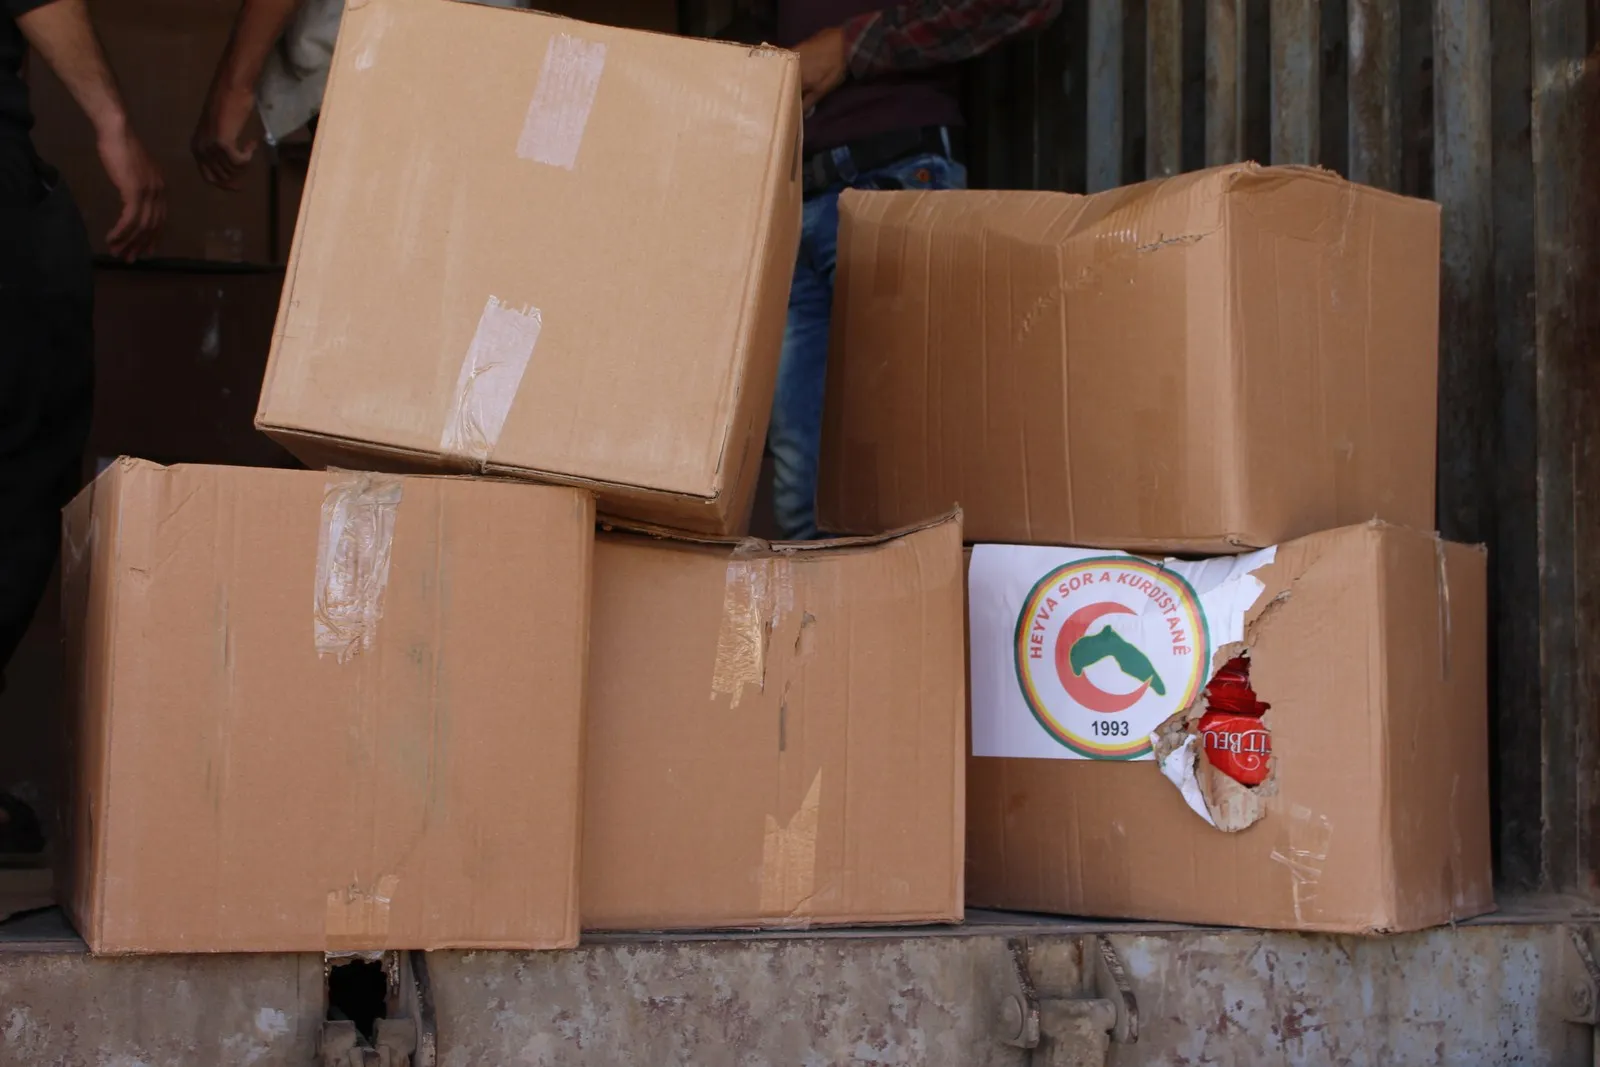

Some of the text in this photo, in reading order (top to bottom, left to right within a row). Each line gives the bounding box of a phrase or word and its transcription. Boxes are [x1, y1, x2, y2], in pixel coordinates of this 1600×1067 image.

[1030, 571, 1192, 659] HEYVA SOR A KURDISTANÊ
[1091, 720, 1130, 736] 1993
